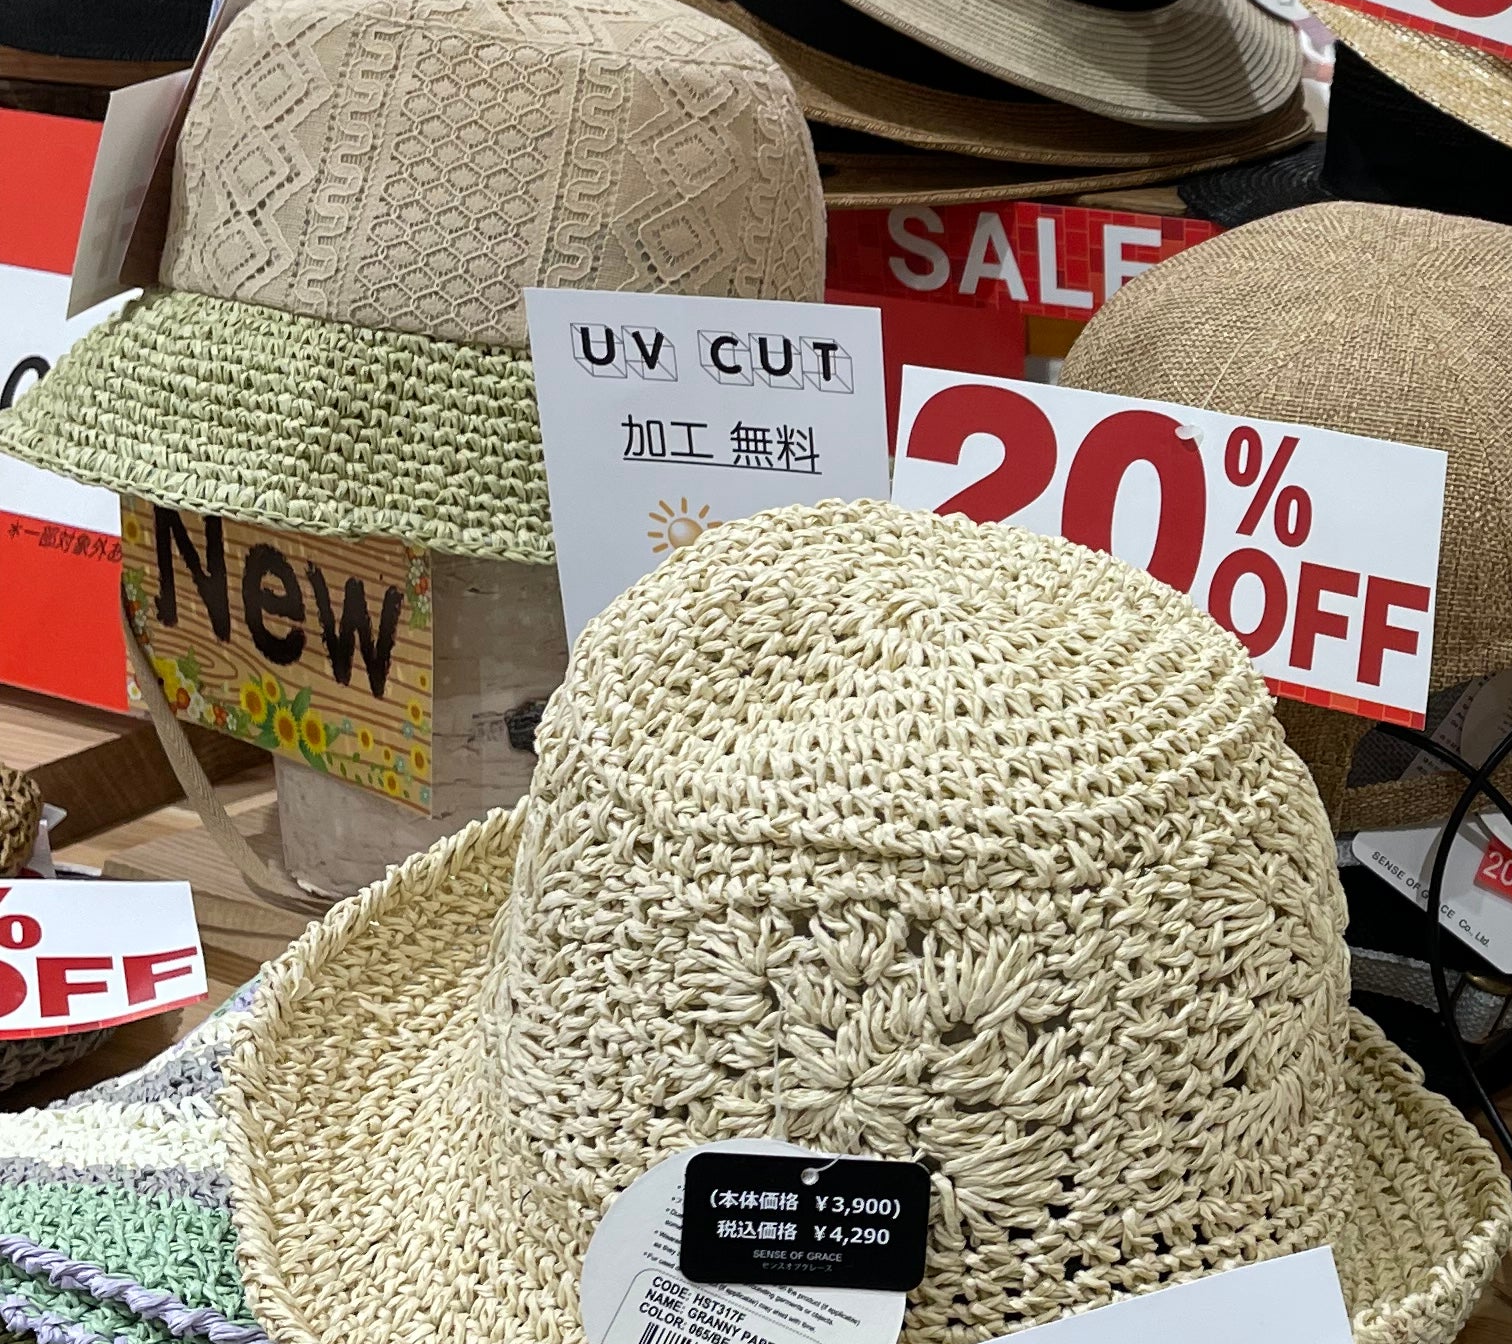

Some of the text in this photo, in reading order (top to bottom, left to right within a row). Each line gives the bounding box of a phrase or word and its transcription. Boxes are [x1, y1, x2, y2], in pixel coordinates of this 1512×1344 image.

[888, 206, 1161, 309] SALE
[580, 324, 839, 384] UV CUT
[621, 413, 821, 471] 加工 無料
[152, 509, 399, 700] New
[1207, 548, 1430, 688] OFF
[1371, 850, 1406, 880] SENSE
[1405, 877, 1421, 890] OF
[1420, 889, 1456, 920] GCE
[709, 1188, 901, 1220] (本体価格 ¥3,900)
[716, 1220, 890, 1247] 税込価格 ¥4,290
[753, 1249, 843, 1263] SENSE OF GRACE
[639, 1302, 687, 1329] COLOR:
[644, 1288, 686, 1315] NAME:
[687, 1304, 742, 1337] GRANNY
[652, 1276, 747, 1323] CODE: HST317F
